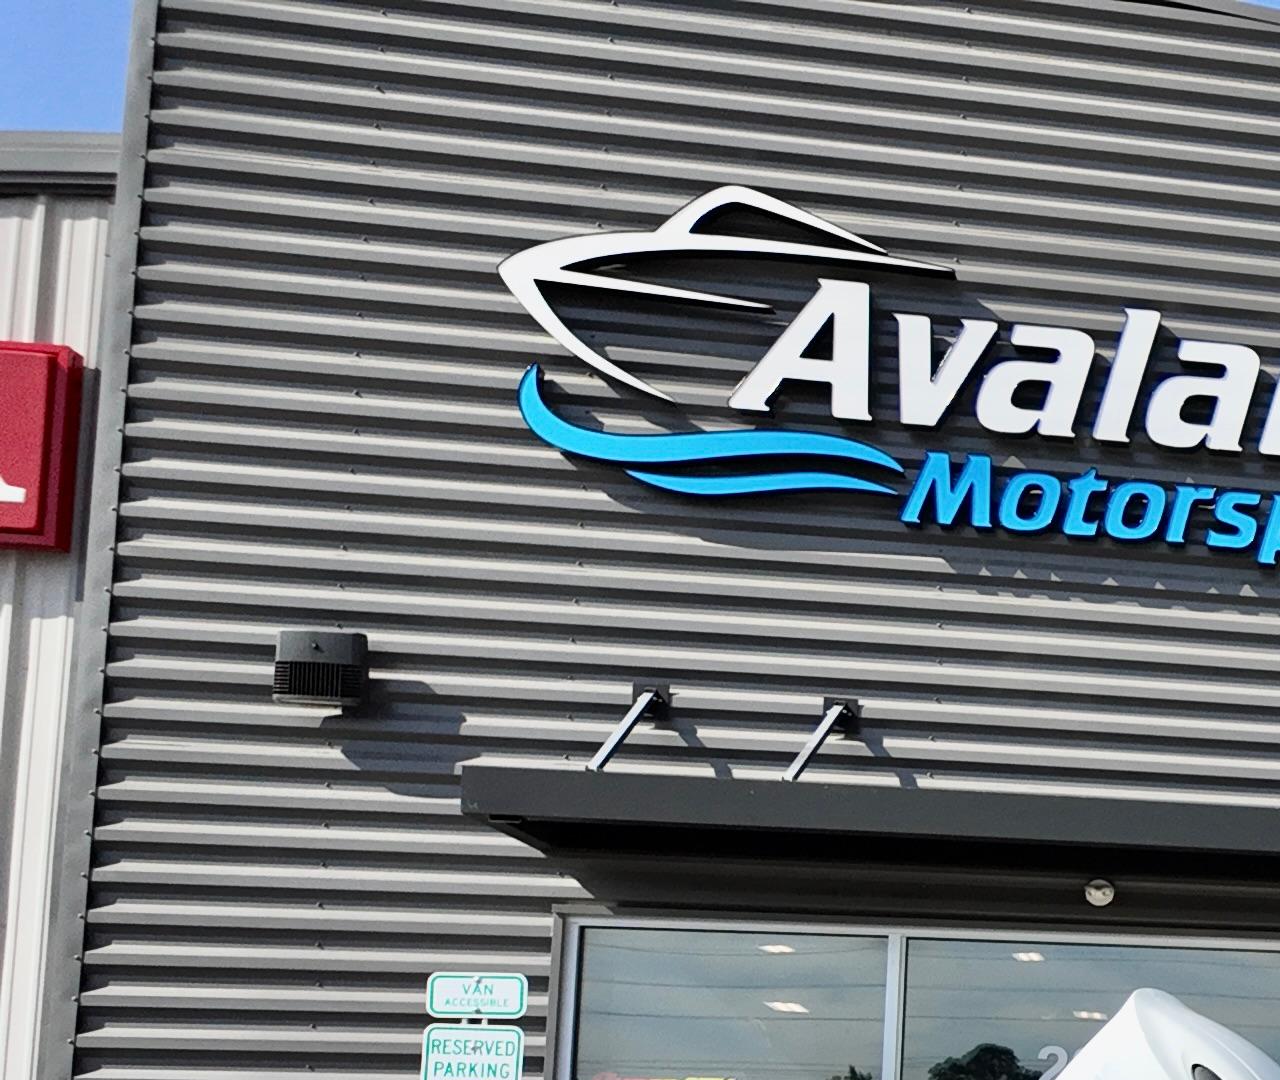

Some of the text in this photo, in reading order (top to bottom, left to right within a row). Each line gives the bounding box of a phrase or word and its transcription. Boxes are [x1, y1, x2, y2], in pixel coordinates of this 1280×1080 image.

[462, 983, 494, 996] VAN
[444, 998, 509, 1008] ACCESSIBLE
[431, 1039, 516, 1057] RESERVED
[433, 1062, 511, 1079] PARKING
